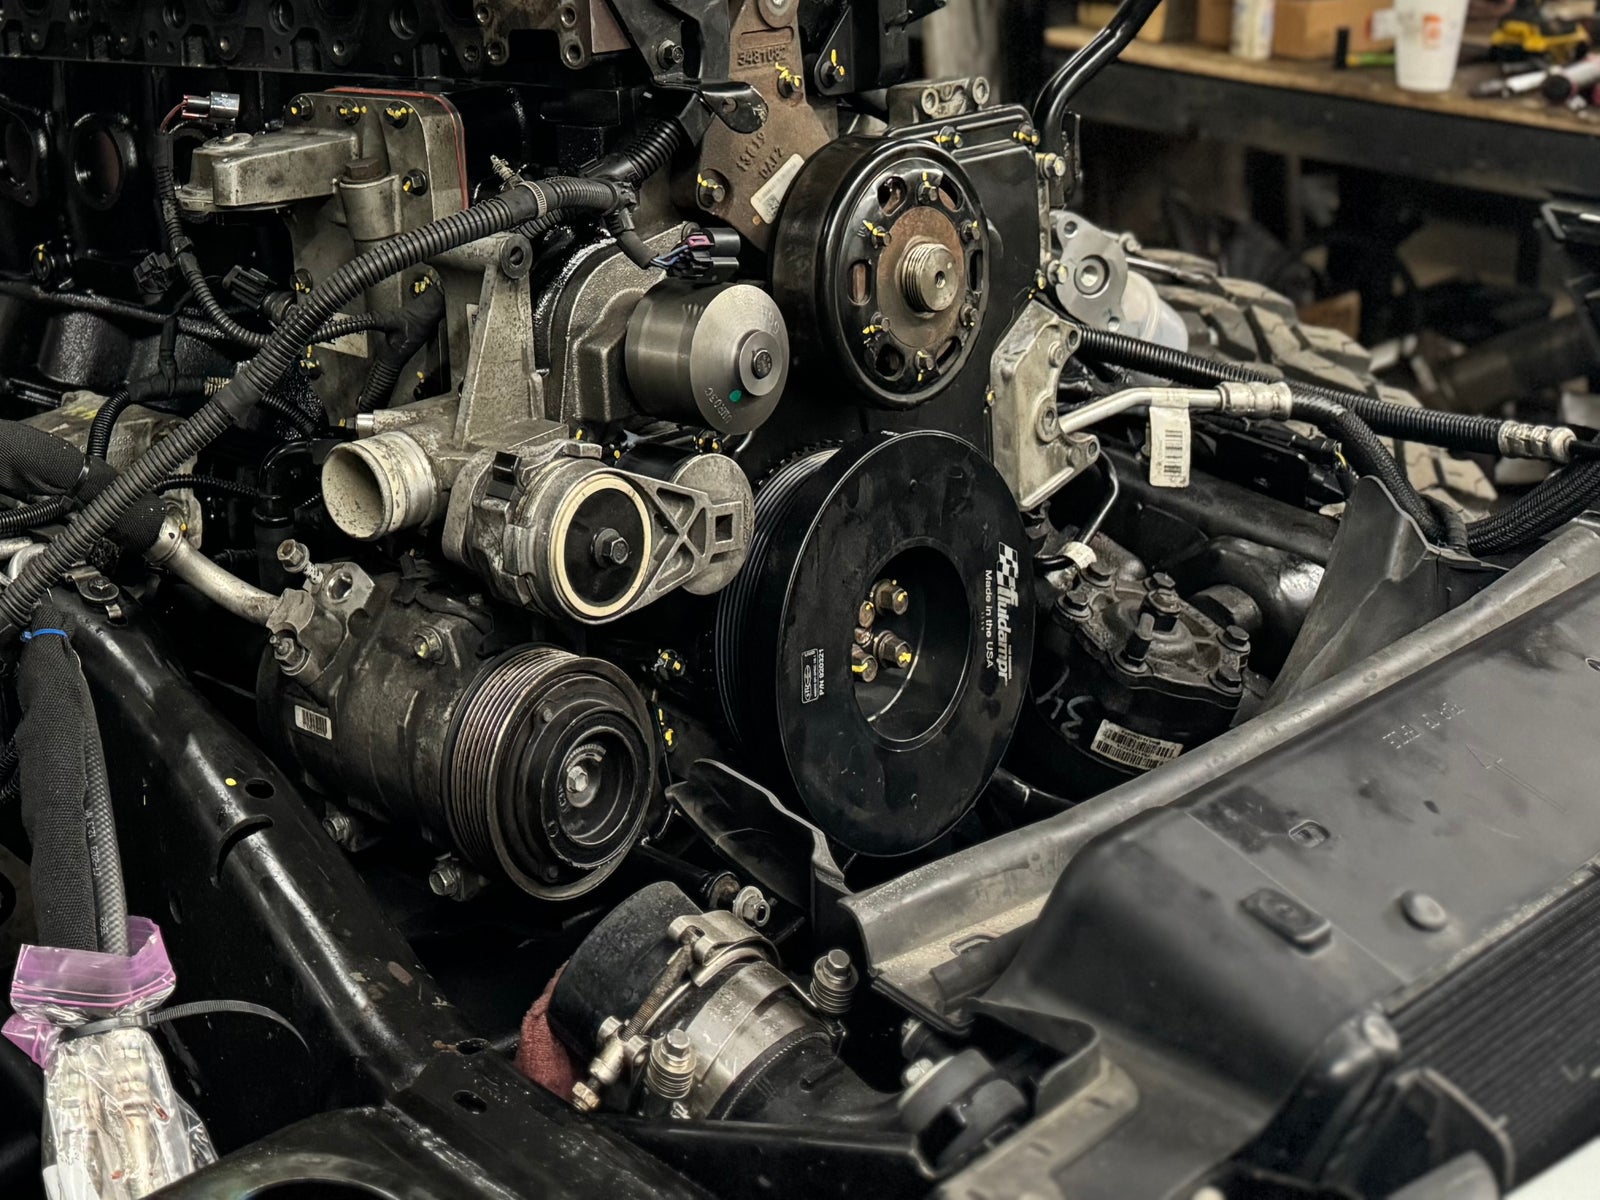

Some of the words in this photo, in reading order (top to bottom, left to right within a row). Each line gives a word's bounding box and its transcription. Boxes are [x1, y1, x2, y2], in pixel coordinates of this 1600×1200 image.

[984, 569, 993, 603] Made
[985, 605, 993, 616] in
[985, 618, 993, 638] the
[986, 641, 994, 669] USA
